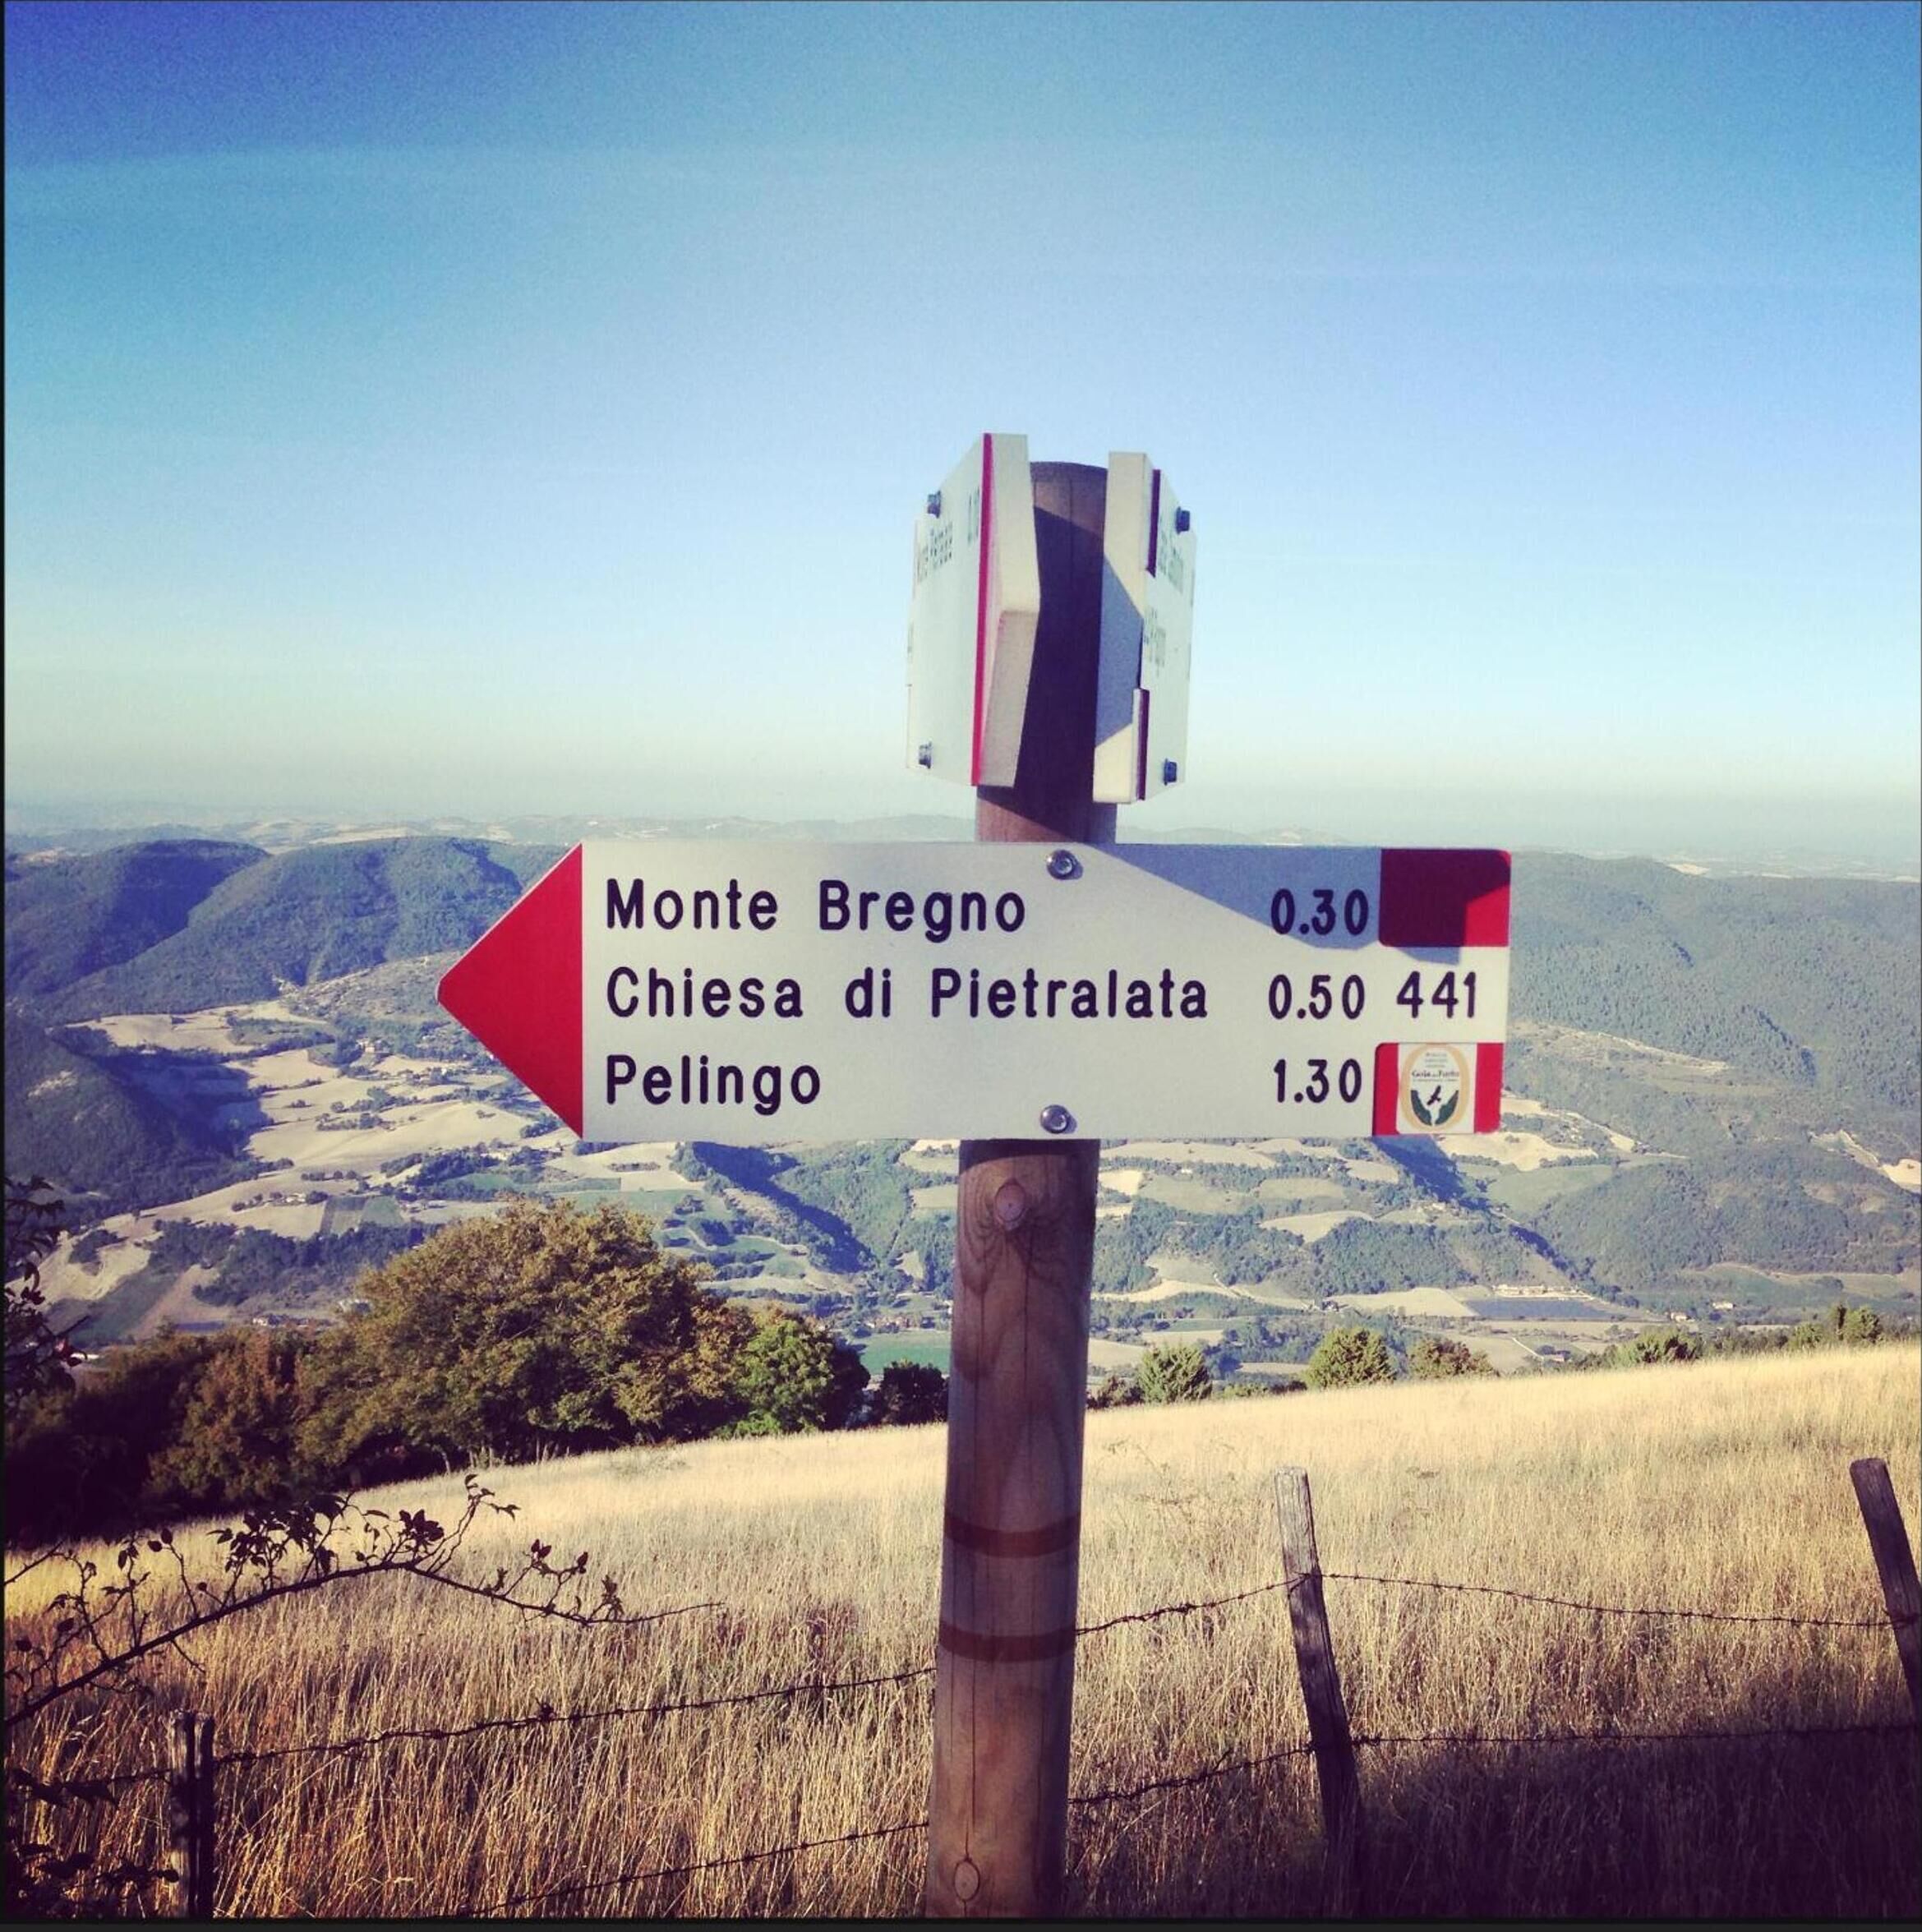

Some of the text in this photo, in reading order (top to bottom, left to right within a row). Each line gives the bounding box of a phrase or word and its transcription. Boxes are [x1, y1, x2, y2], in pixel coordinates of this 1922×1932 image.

[606, 878, 1370, 943] Monte Bregno 0.30
[606, 966, 1365, 1020] Chiesa di Pietralata 0.50
[1396, 971, 1476, 1019] 441
[606, 1054, 1362, 1116] Pelingo 1.30
